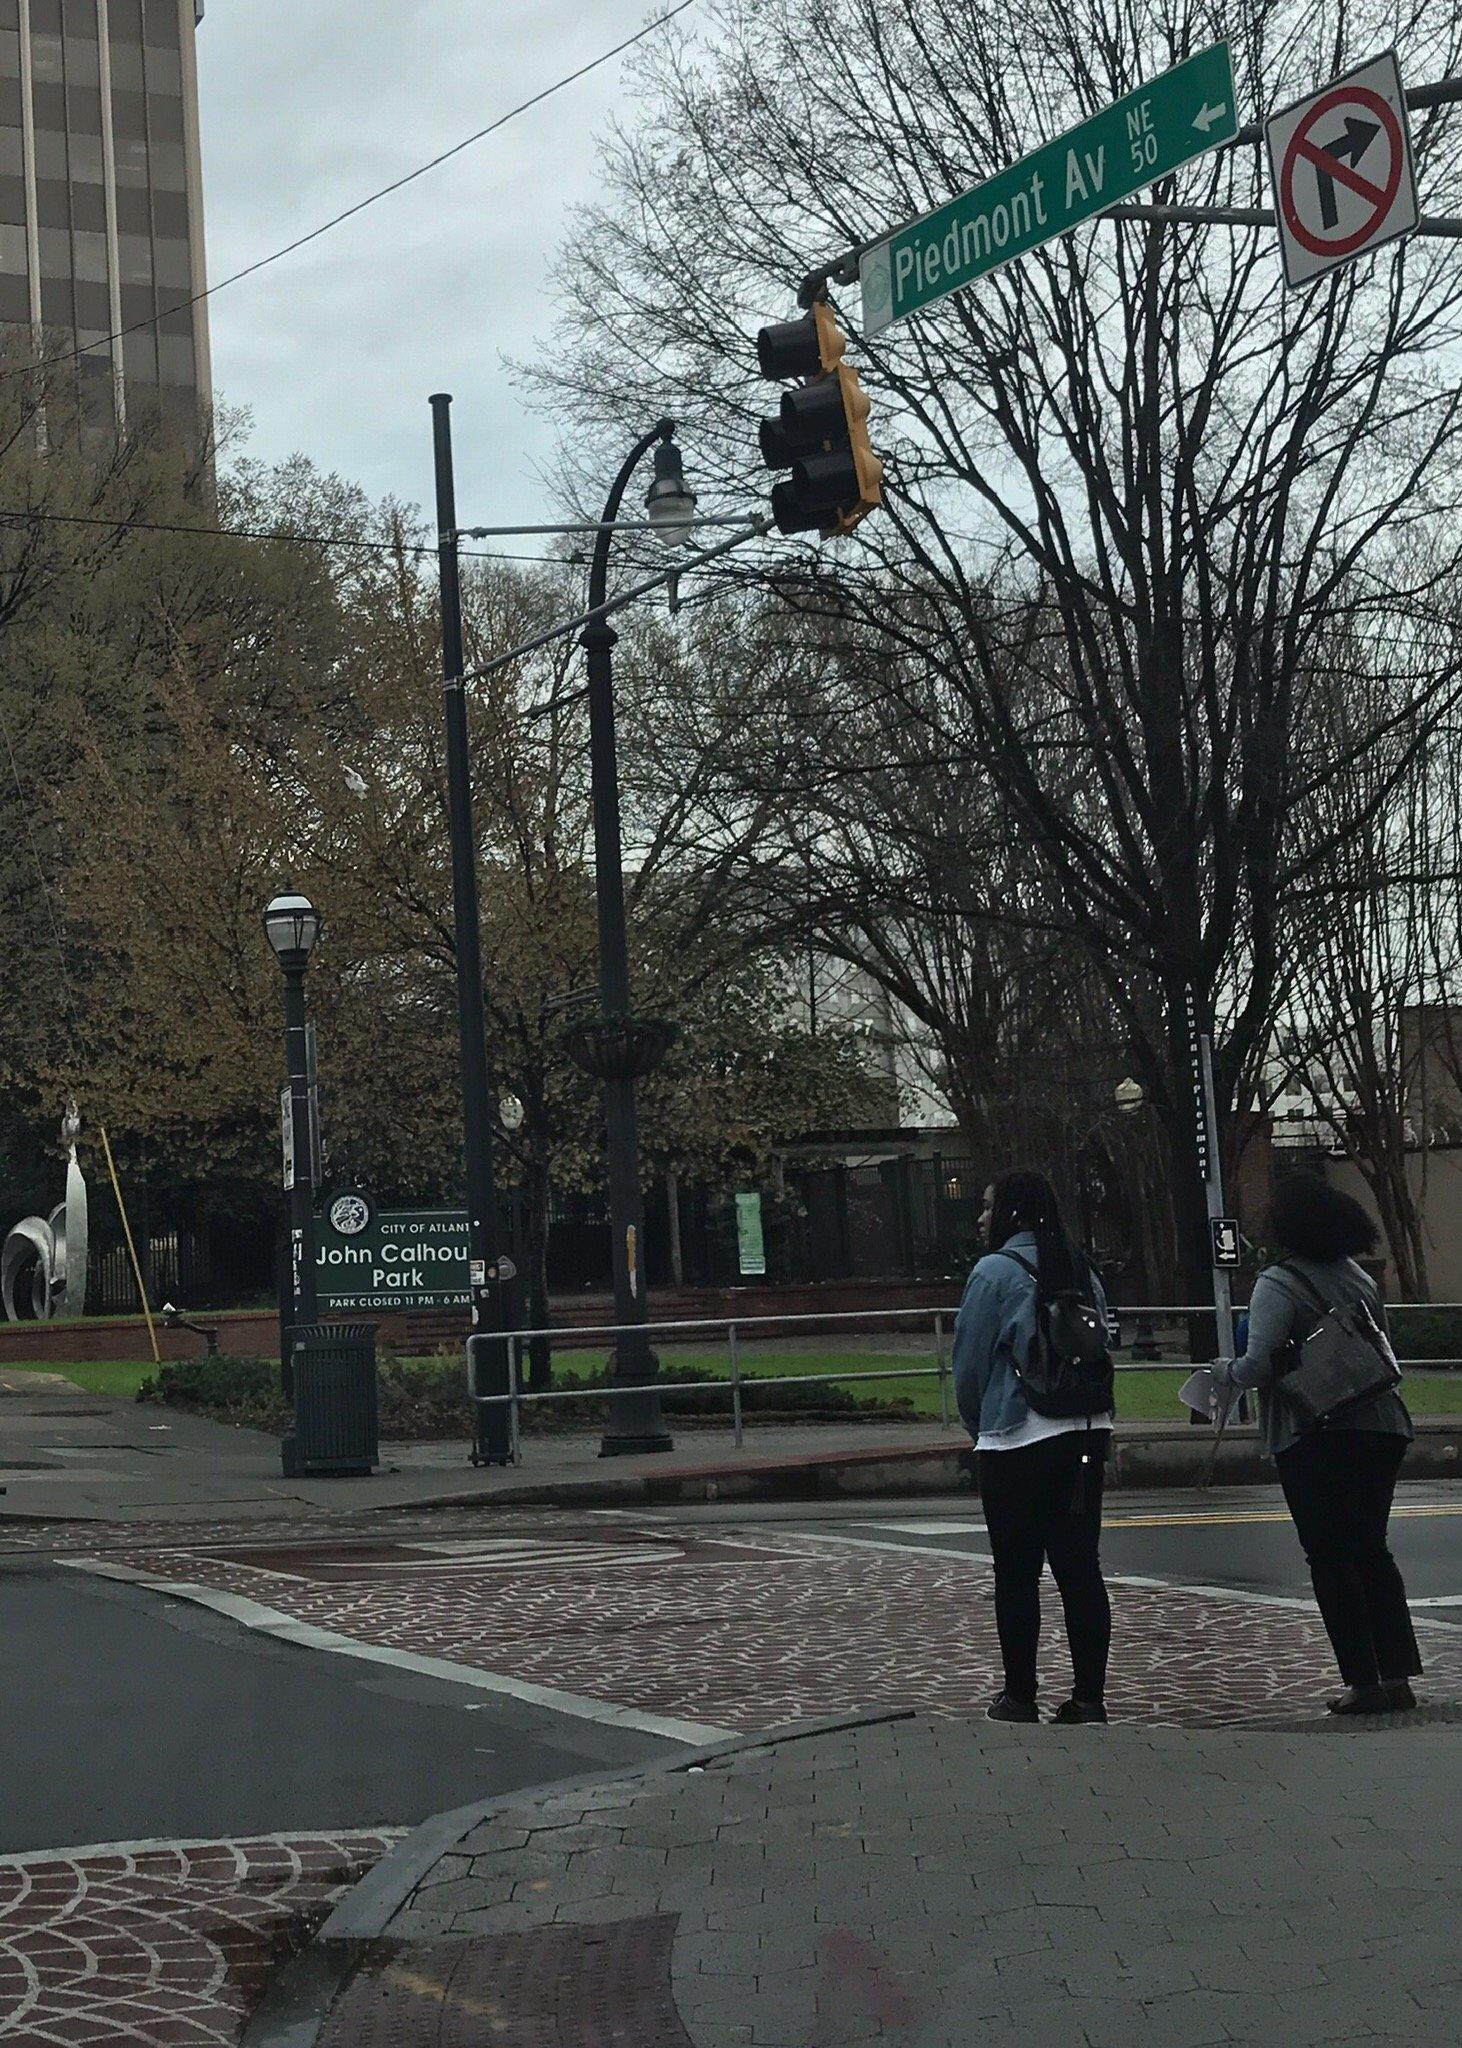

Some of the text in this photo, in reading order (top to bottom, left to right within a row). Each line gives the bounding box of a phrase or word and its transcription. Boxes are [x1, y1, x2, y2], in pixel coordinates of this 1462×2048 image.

[1126, 99, 1153, 140] NE
[1130, 137, 1159, 174] 50
[895, 144, 1105, 303] Piedmont Av
[1185, 983, 1198, 1052] Auburn
[381, 1224, 406, 1234] CITY
[409, 1223, 425, 1233] OF
[316, 1243, 467, 1265] John Calhou
[373, 1267, 424, 1288] Park
[329, 1298, 356, 1307] PARK
[359, 1297, 401, 1307] CLOSED
[405, 1297, 414, 1305] 11
[418, 1296, 434, 1305] PM
[443, 1295, 450, 1304] 6
[453, 1294, 470, 1304] AM
